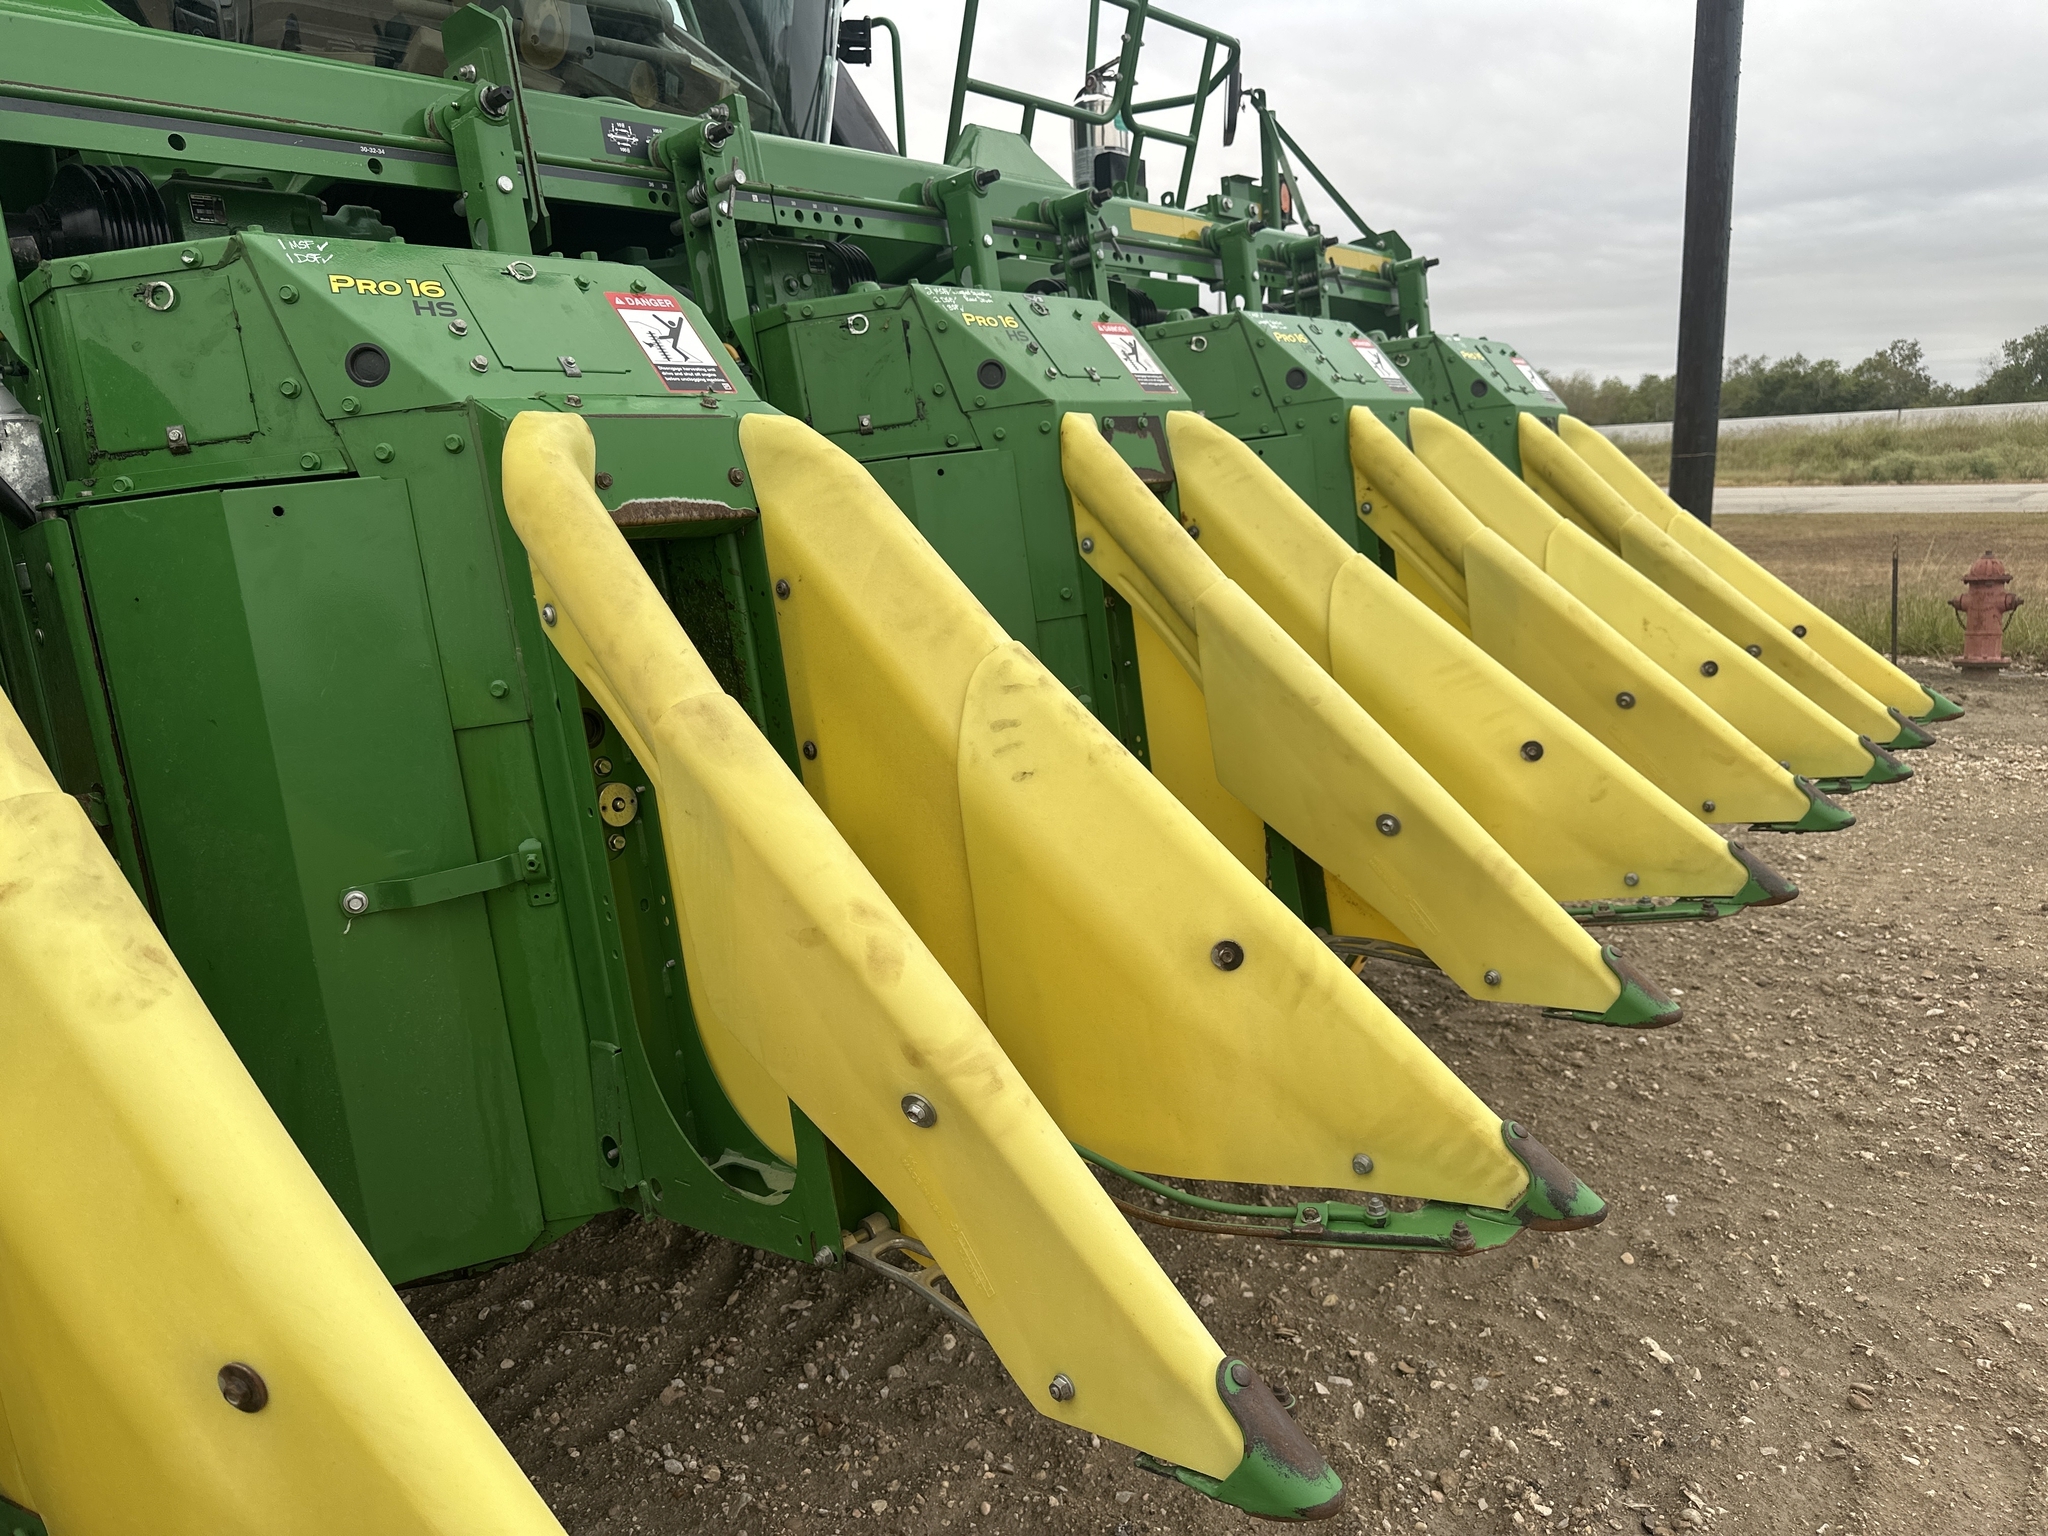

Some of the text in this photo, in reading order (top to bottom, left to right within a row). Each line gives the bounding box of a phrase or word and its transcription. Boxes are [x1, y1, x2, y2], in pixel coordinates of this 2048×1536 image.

[405, 278, 447, 299] 16
[412, 300, 458, 317] HS
[624, 297, 675, 308] DANGER
[997, 315, 1019, 328] 16
[1005, 329, 1029, 341] HS
[1294, 333, 1309, 344] 16
